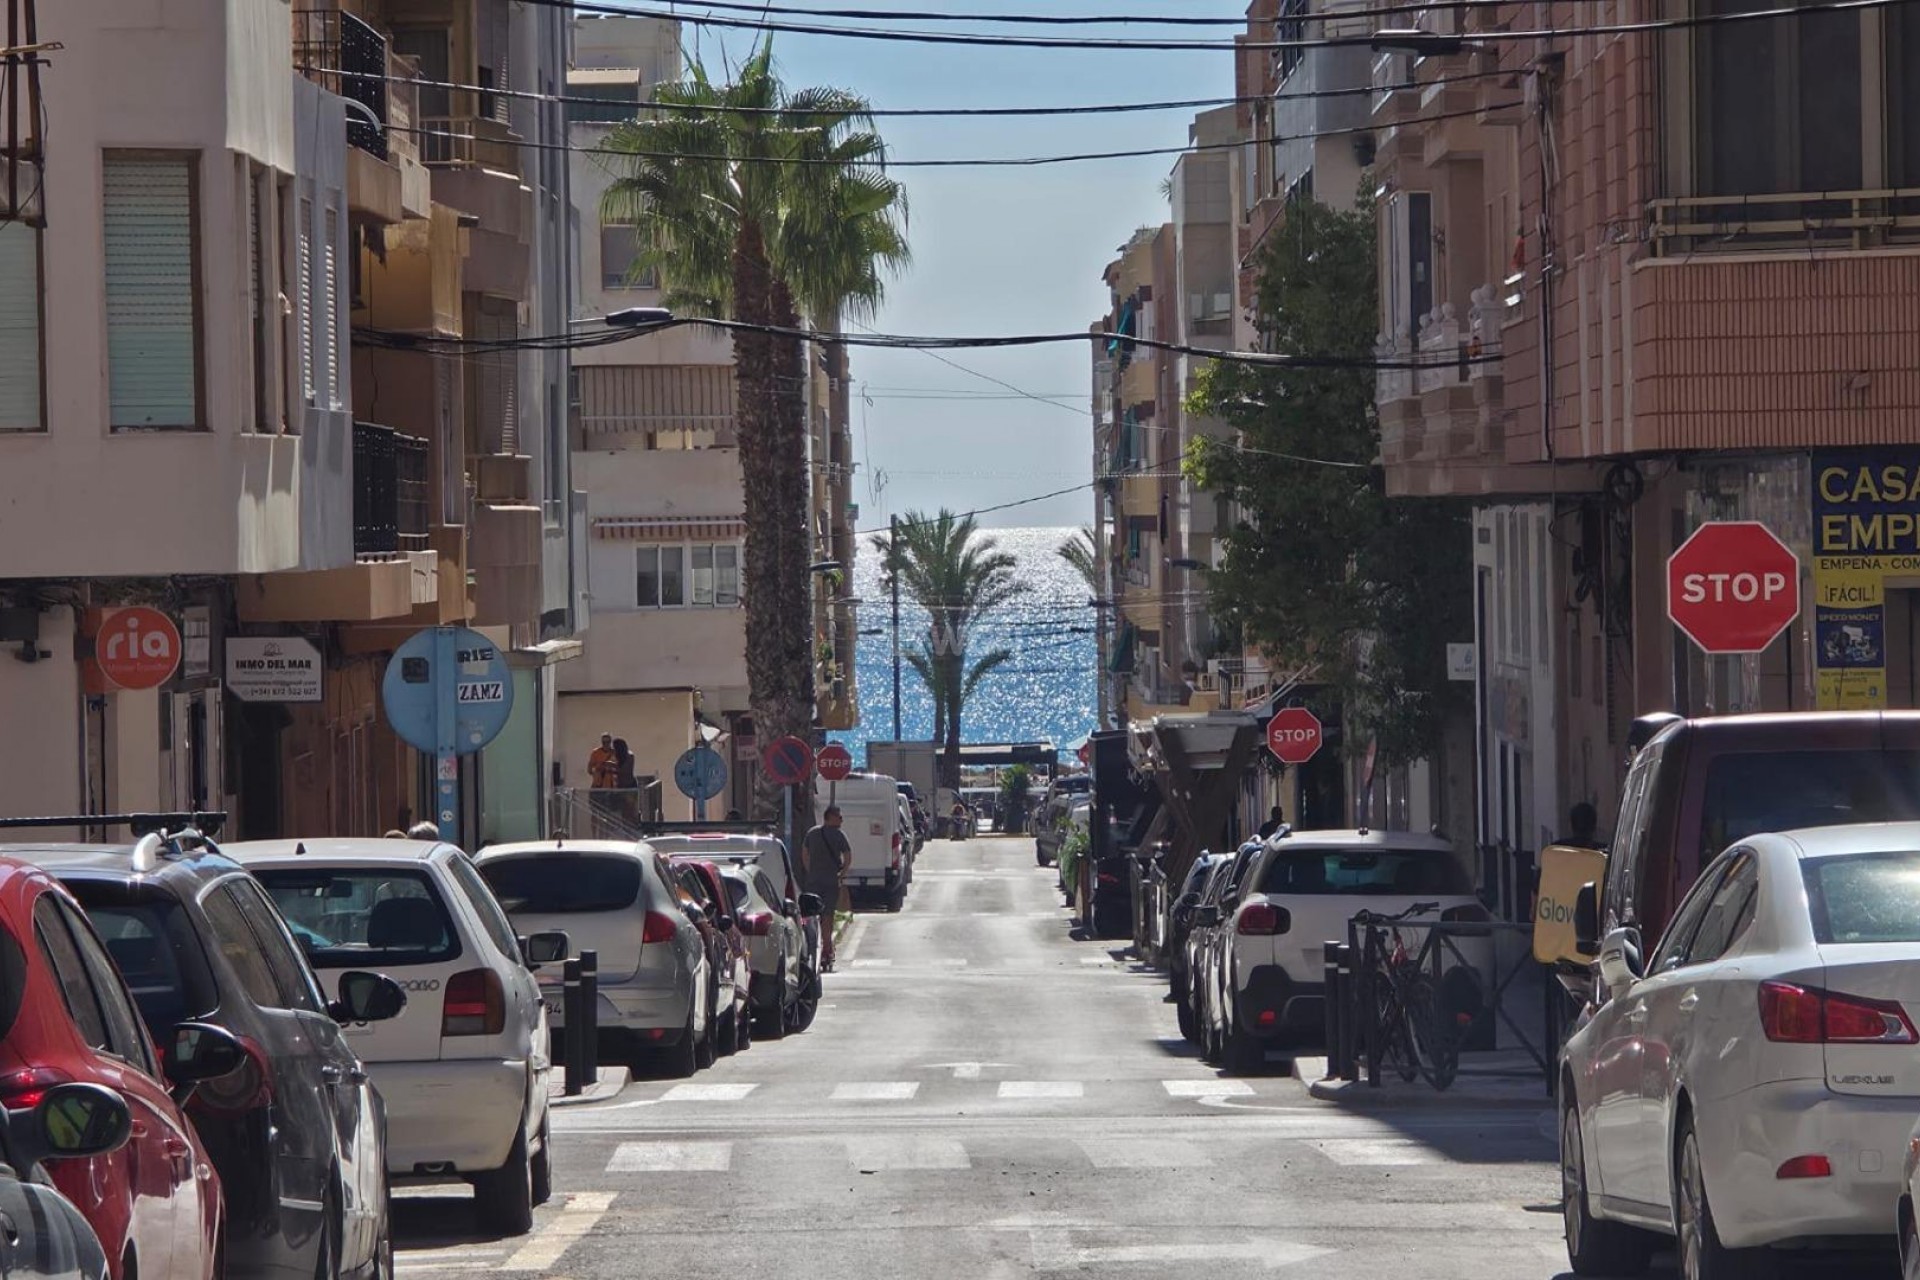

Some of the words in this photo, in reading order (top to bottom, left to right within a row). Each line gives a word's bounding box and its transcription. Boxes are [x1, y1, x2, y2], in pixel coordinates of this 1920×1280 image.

[1821, 514, 1920, 550] EMP
[1821, 555, 1882, 570] EMPEÑA
[1682, 573, 1785, 603] STOP
[106, 617, 170, 659] ria
[235, 659, 265, 670] INMO
[267, 659, 285, 670] DEL
[288, 659, 311, 669] MAR
[459, 684, 501, 701] ZAMZ
[1273, 728, 1316, 742] STOP
[819, 758, 849, 768] STOP
[1832, 1074, 1895, 1085] LEXUS
